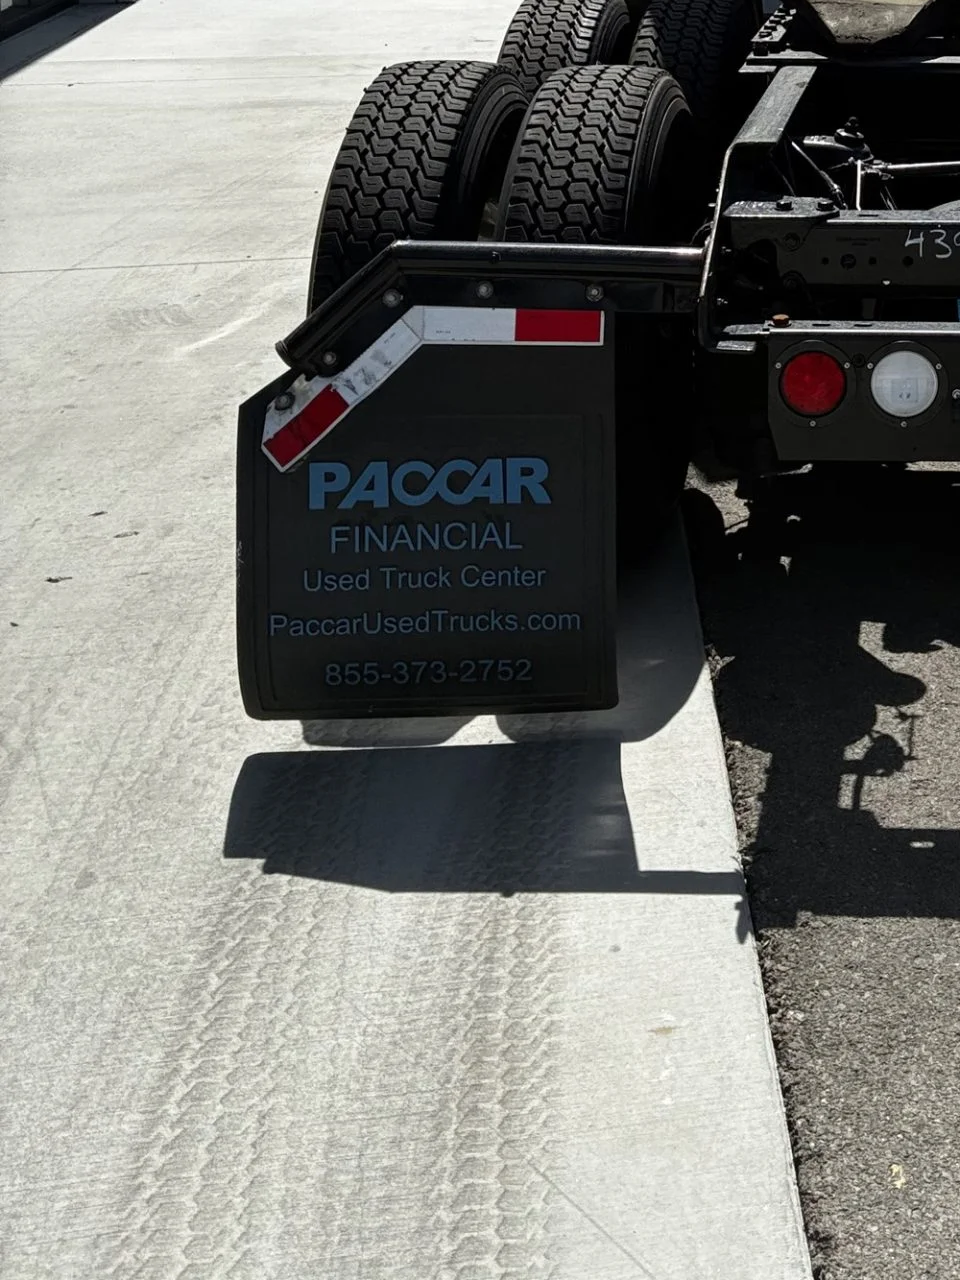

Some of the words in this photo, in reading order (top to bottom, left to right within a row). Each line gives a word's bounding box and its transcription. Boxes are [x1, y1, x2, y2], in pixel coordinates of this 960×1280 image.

[308, 458, 552, 509] PACCAR
[330, 522, 523, 553] FINANCIAL
[303, 568, 370, 591] Used
[380, 566, 451, 589] Truck
[461, 564, 546, 587] Center
[269, 610, 581, 636] PaccarUsedTrucks.com
[325, 659, 532, 685] 855-373-2752
